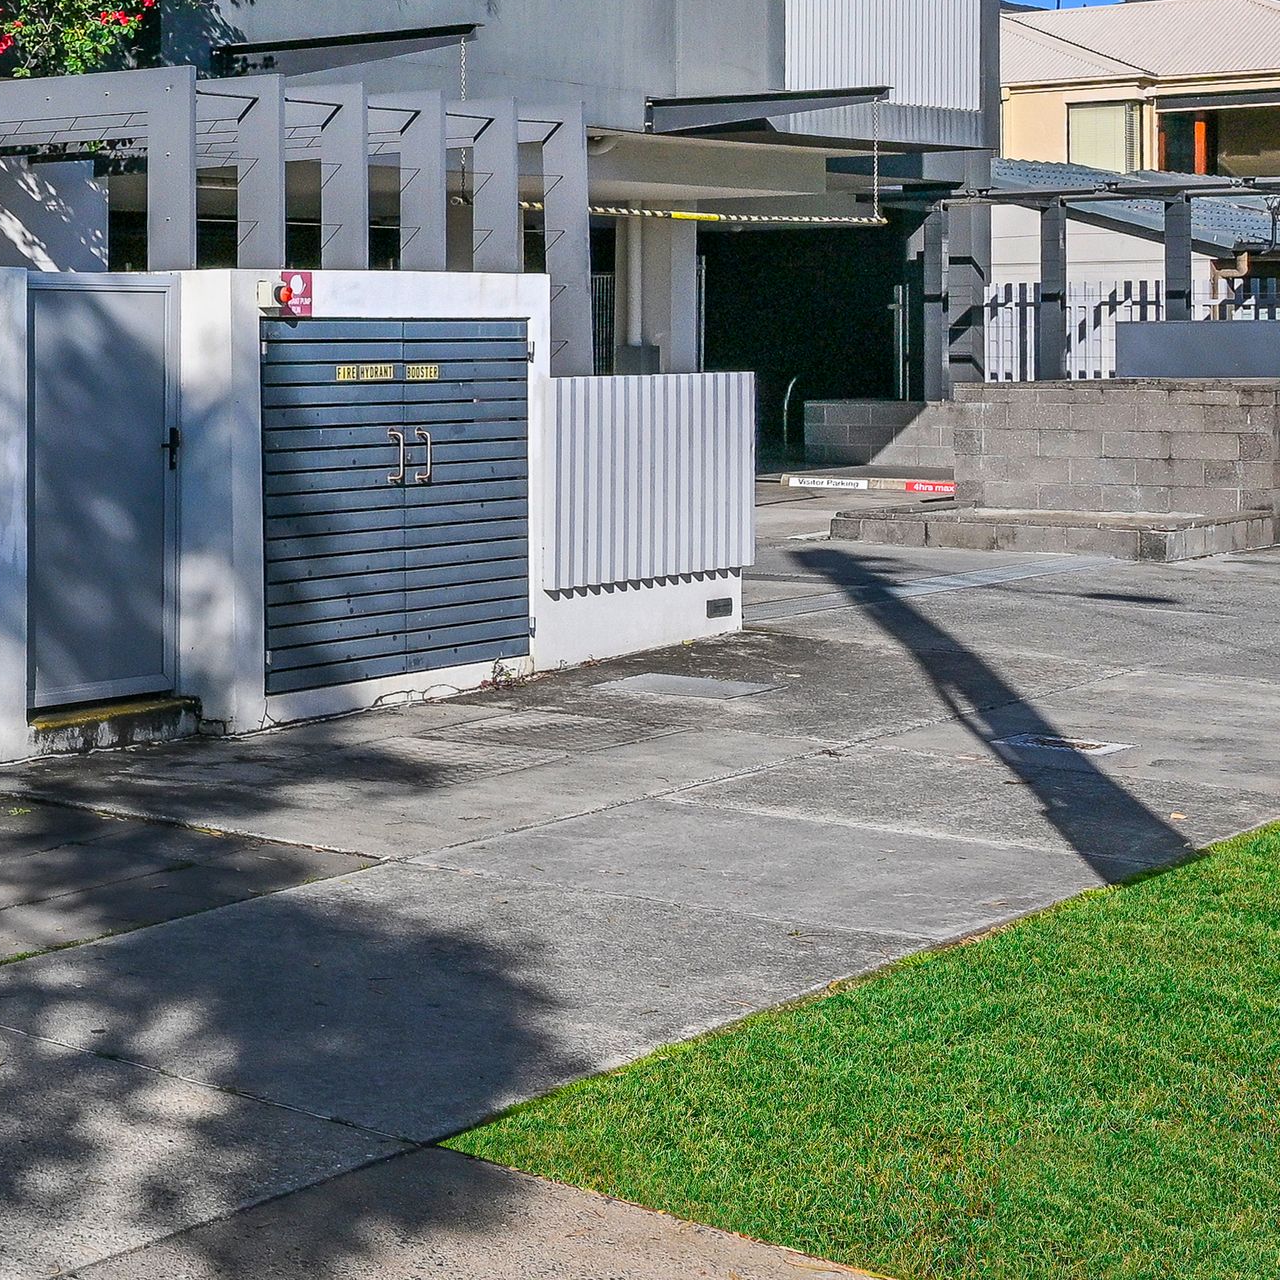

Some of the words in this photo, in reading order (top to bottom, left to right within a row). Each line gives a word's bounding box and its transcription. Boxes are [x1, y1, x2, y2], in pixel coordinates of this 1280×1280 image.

[337, 367, 356, 379] FIRE
[360, 366, 393, 378] HYDRANT
[407, 366, 438, 378] BOOSTER
[798, 478, 824, 486] Visitor
[826, 479, 860, 488] Parking
